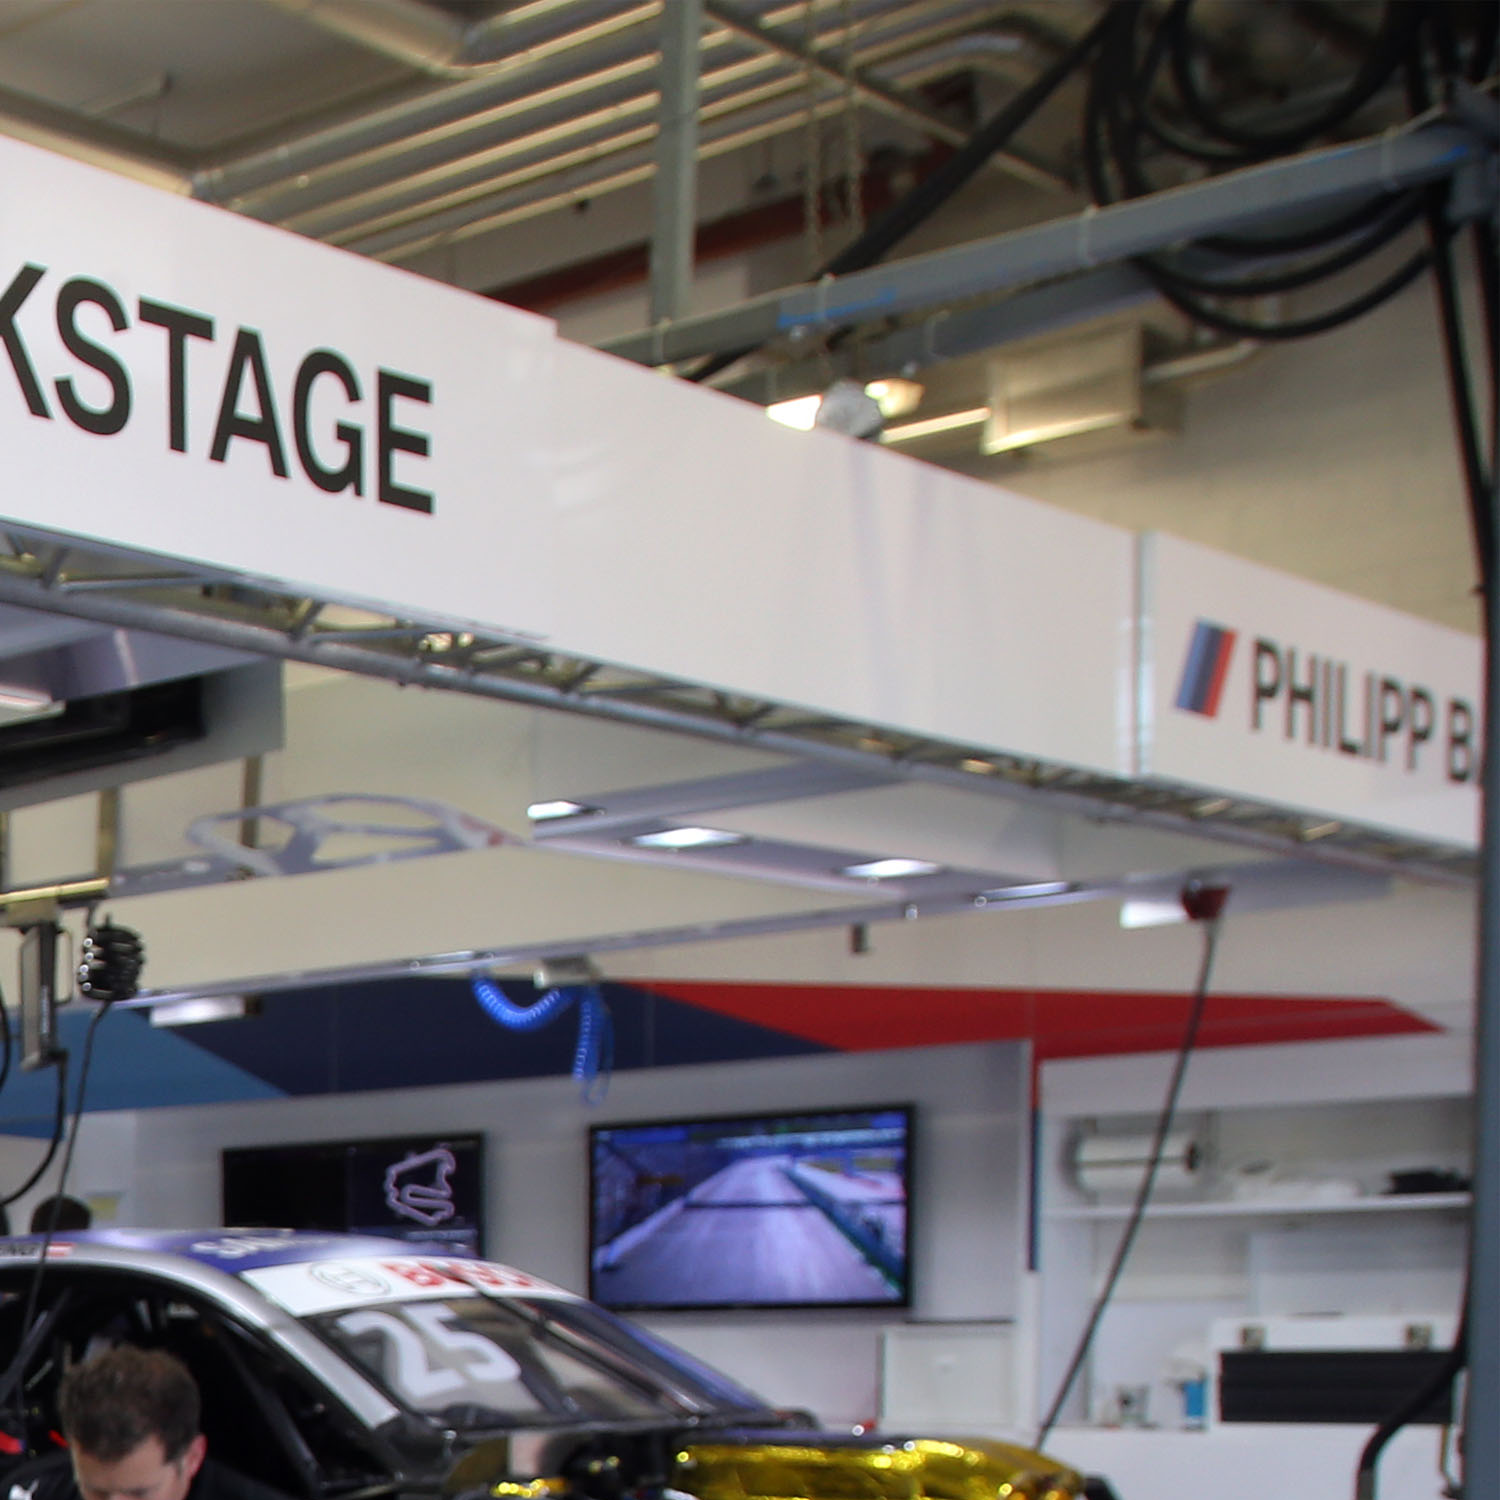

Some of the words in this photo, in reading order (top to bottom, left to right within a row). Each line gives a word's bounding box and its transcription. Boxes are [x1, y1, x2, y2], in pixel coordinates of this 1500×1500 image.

[1251, 635, 1434, 773] PHILIPP
[1447, 697, 1480, 784] B
[336, 1302, 522, 1398] 25
